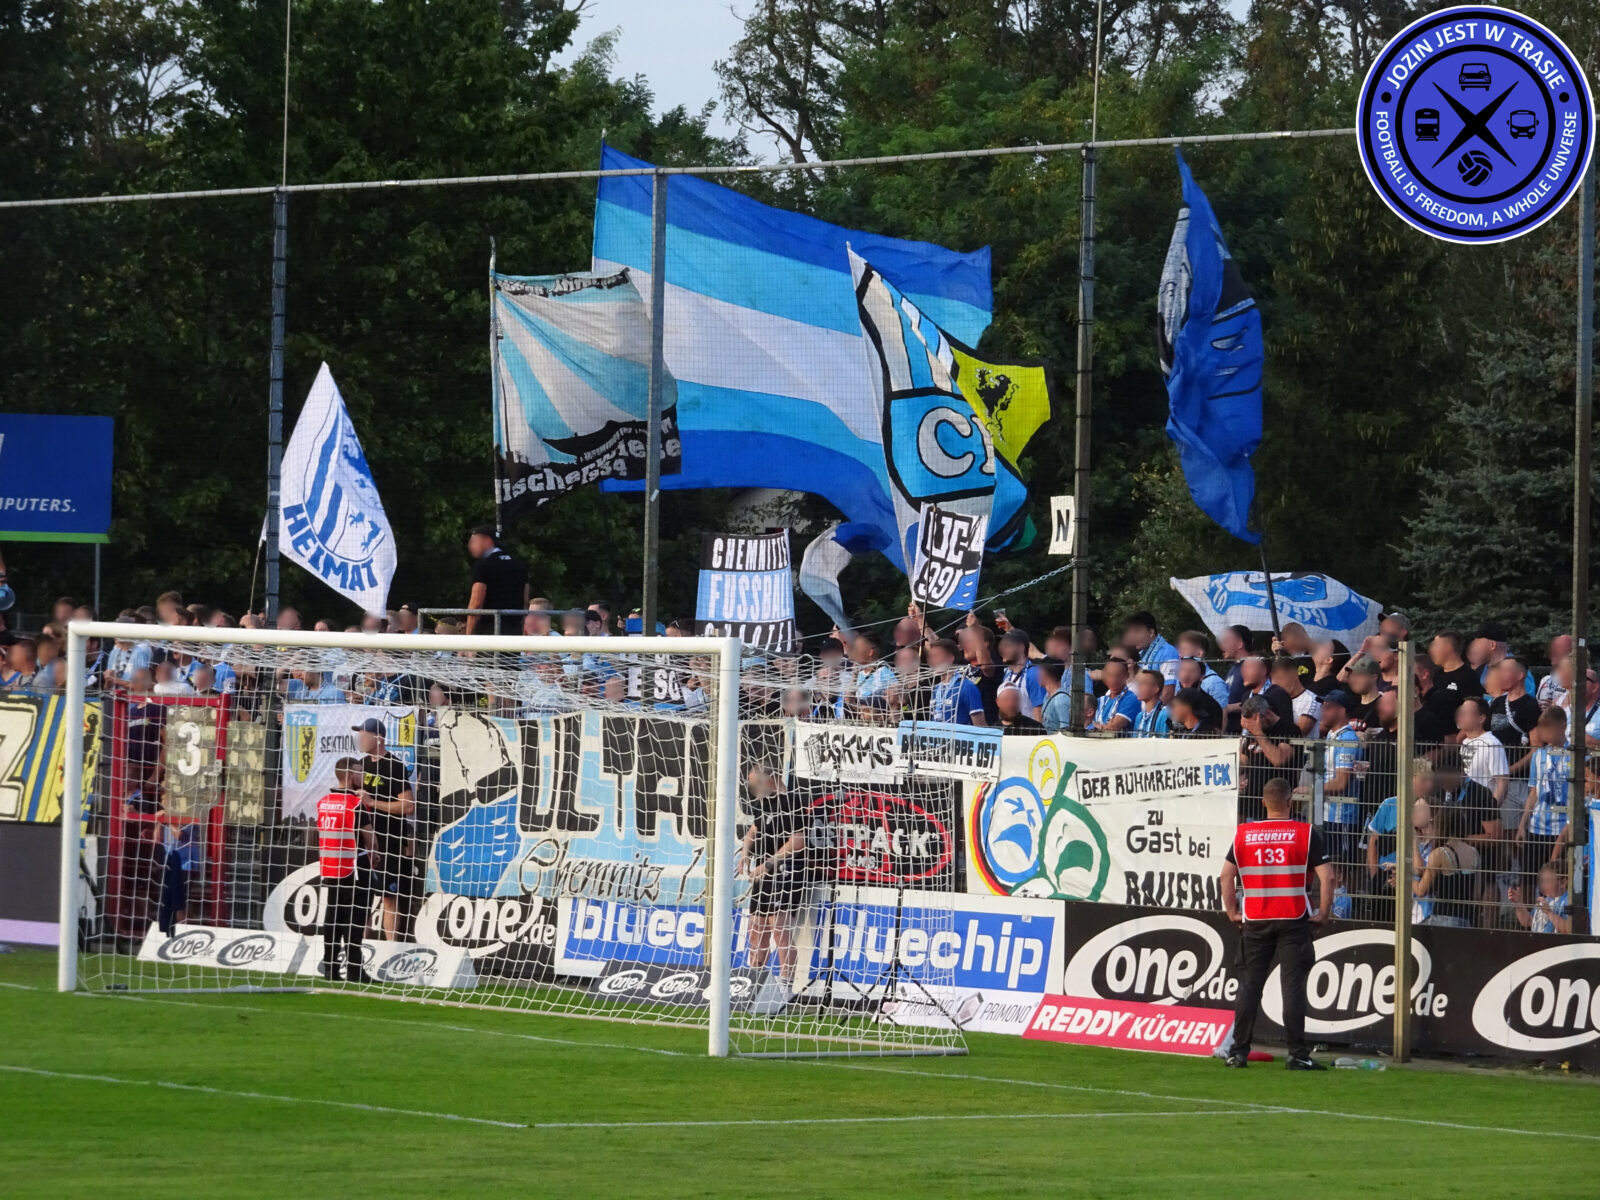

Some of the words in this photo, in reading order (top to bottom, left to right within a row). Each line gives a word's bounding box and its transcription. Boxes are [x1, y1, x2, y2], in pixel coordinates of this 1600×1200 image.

[0, 497, 76, 513] PUTERS.
[283, 503, 379, 592] HEIMAT
[709, 571, 791, 621] FUSSBALL
[178, 722, 200, 776] 3
[976, 742, 997, 769] OST
[1082, 776, 1110, 799] DER
[1115, 766, 1201, 795] RUHMREICHE
[1204, 763, 1232, 785] FCK
[320, 816, 337, 829] 107
[1126, 825, 1182, 855] Gast
[1188, 836, 1210, 858] bei
[1245, 833, 1295, 842] SECURITY
[519, 838, 664, 902] Chemnitz
[1254, 848, 1285, 864] 133
[449, 896, 555, 944] one.de
[574, 898, 706, 949] bluec
[173, 937, 214, 957] one.de
[232, 941, 276, 962] one.de
[820, 912, 1044, 989] bluechip
[1106, 945, 1239, 1001] one.de
[981, 1002, 1031, 1024] PRIMONO
[1520, 975, 1600, 1029] on
[1032, 1006, 1132, 1037] REDDY
[1127, 1014, 1226, 1046] KÜCHEN
